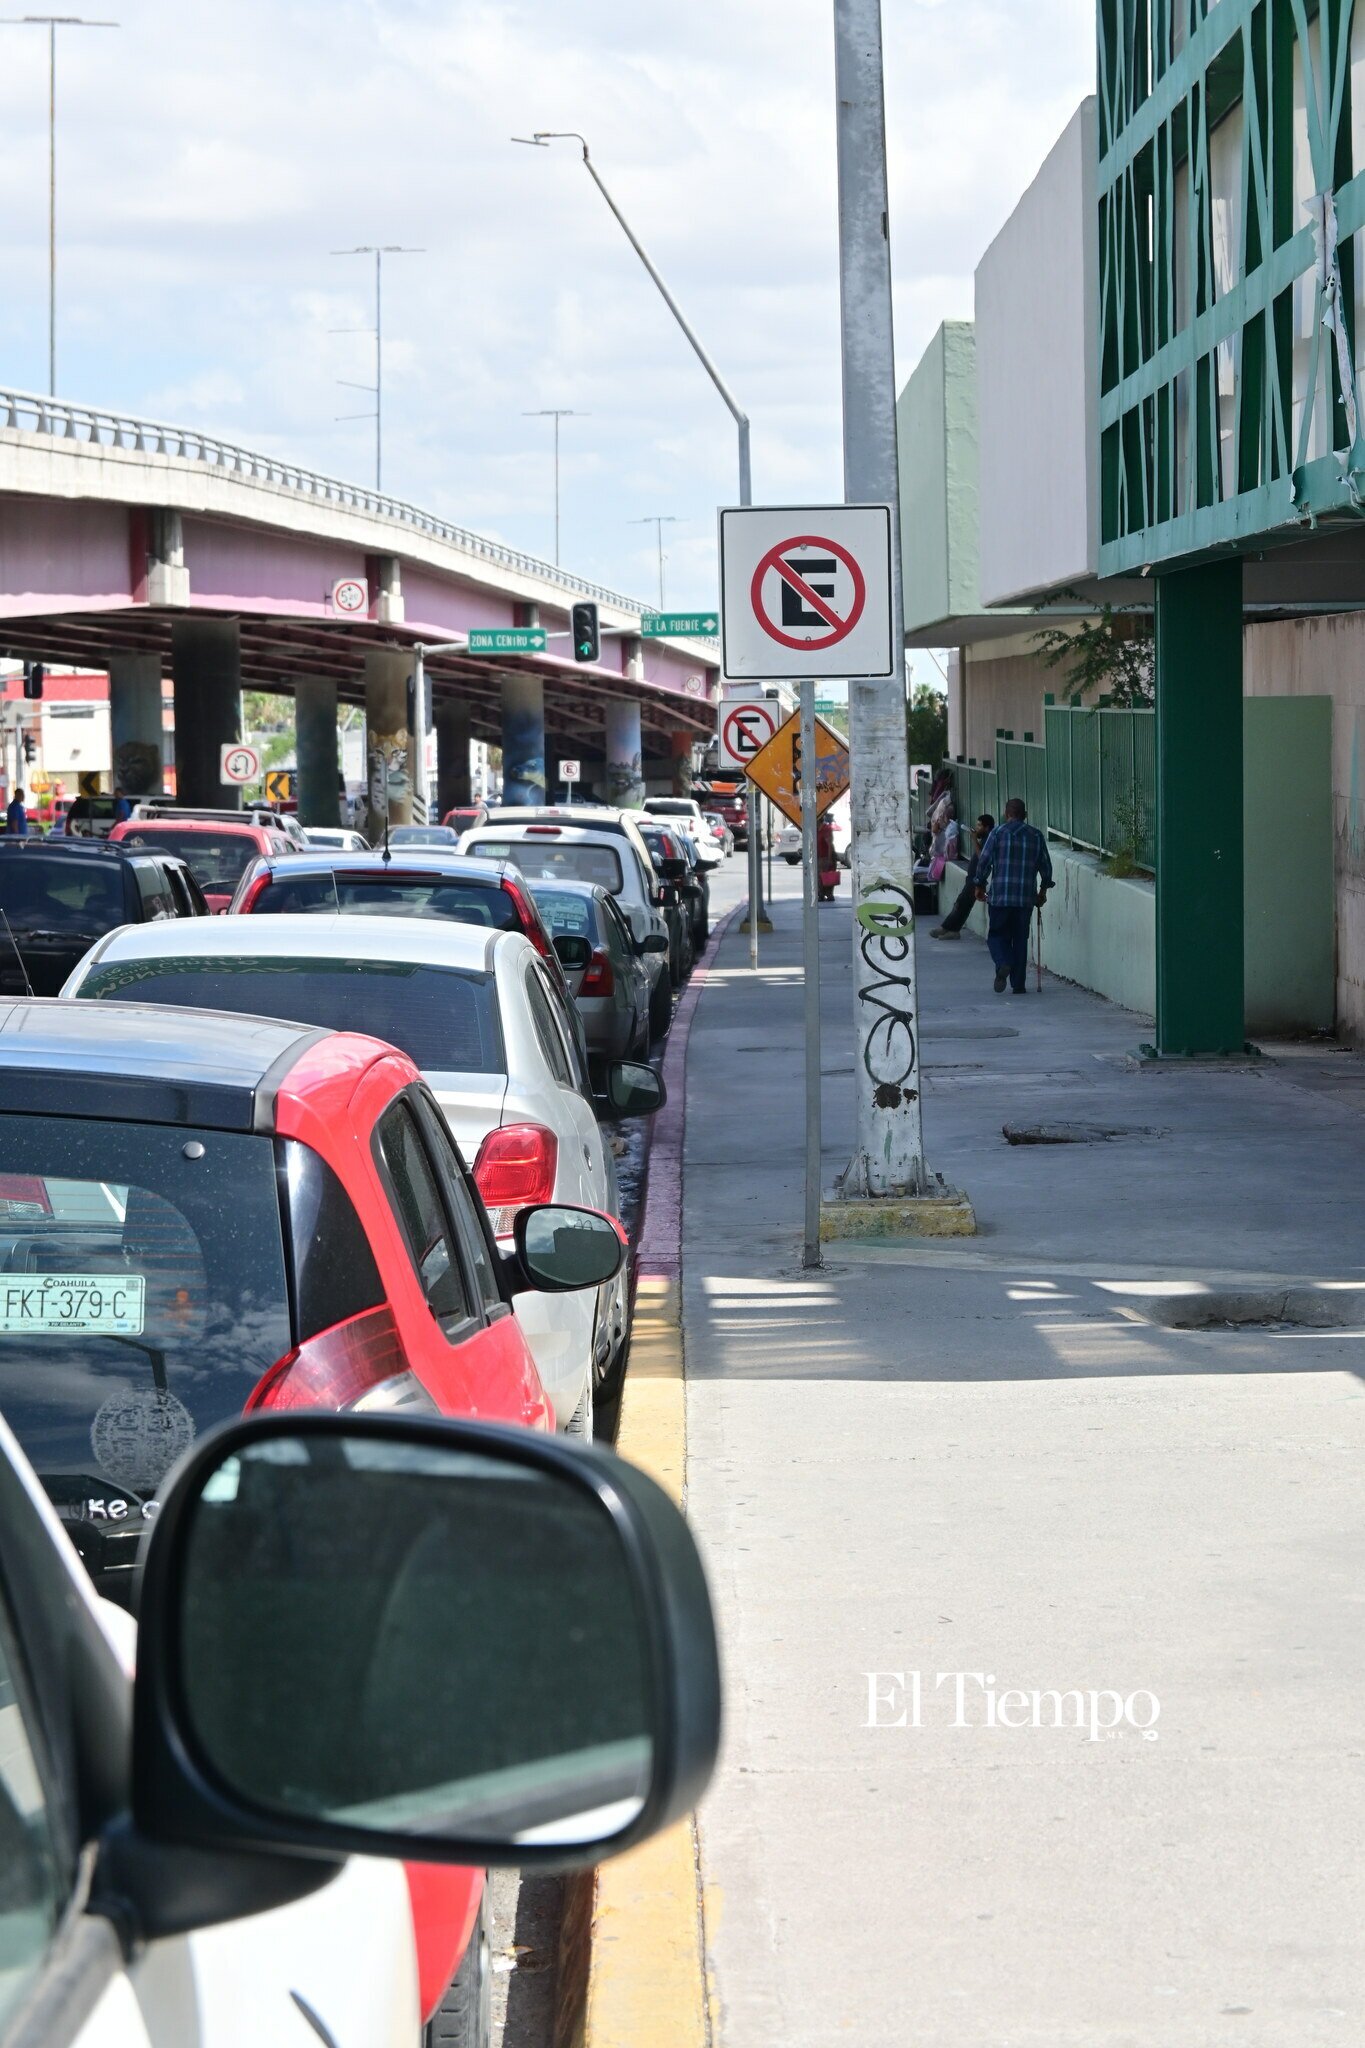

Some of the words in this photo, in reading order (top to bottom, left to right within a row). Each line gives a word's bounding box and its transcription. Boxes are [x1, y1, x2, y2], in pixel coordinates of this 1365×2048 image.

[781, 559, 838, 627] E
[643, 620, 653, 632] DE
[656, 620, 667, 632] LA
[670, 619, 700, 632] FUENTE
[471, 634, 494, 647] ZONA
[496, 634, 528, 647] CENTRO
[43, 1278, 97, 1289] COAHUILA
[6, 1289, 127, 1319] FKT-379-C
